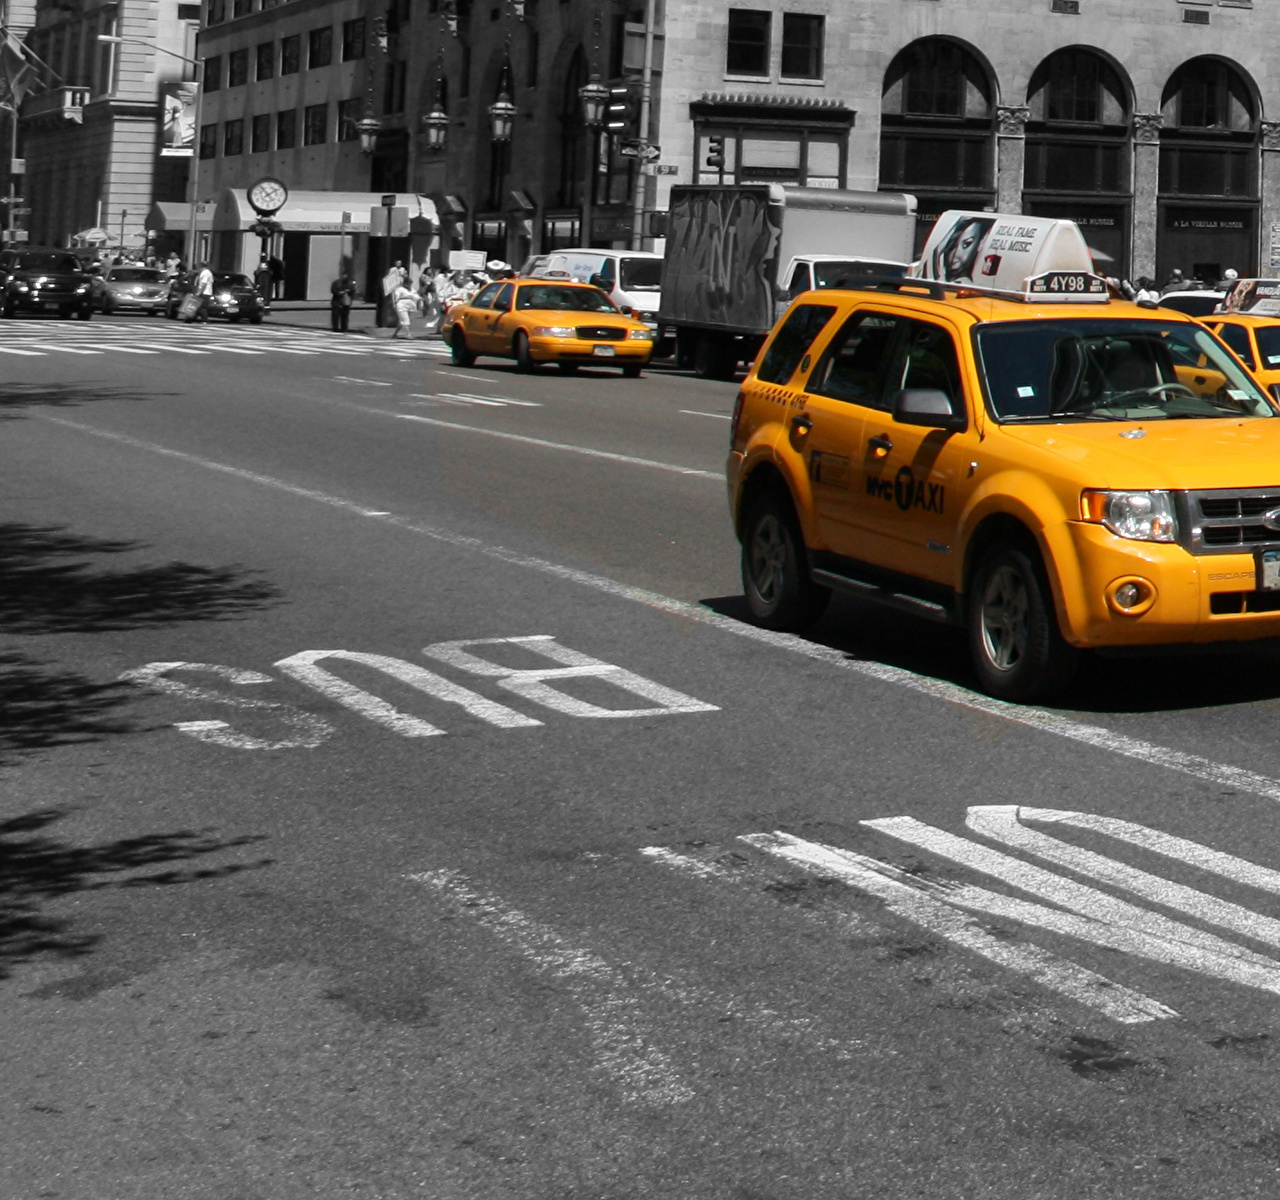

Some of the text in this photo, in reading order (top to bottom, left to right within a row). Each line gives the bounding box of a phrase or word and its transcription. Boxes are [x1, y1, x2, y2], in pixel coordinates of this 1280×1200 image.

[996, 225, 1014, 236] REAL
[989, 238, 1009, 250] REAL
[1050, 275, 1084, 291] 4Y98
